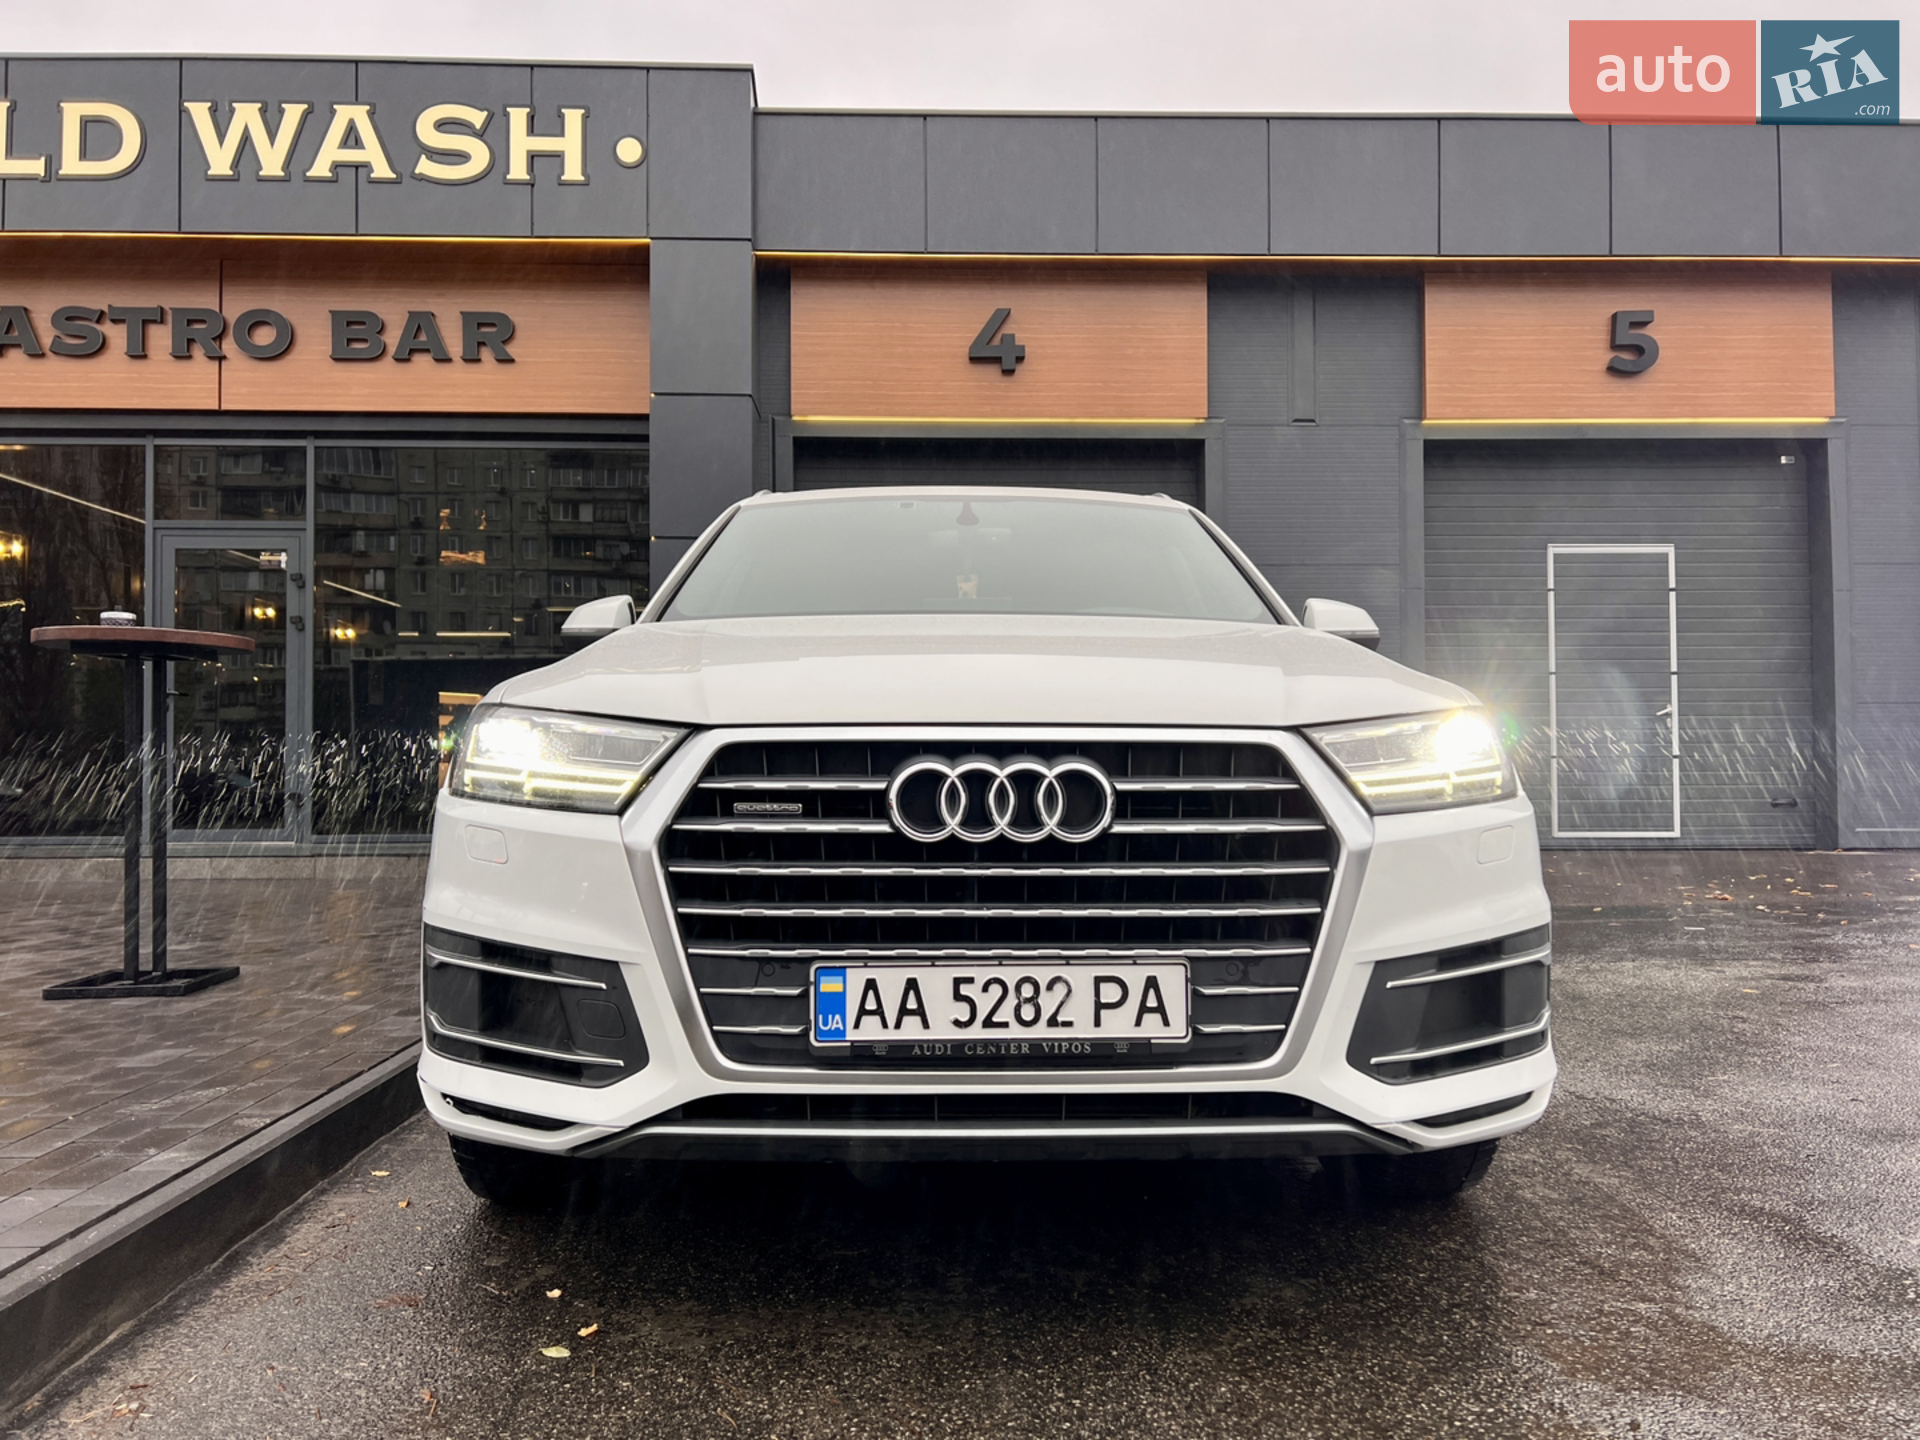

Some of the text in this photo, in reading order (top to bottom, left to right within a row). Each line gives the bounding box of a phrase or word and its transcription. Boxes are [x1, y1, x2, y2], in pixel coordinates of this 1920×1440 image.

[183, 101, 589, 183] WASH
[0, 305, 516, 362] ASTRO BAR
[968, 307, 1026, 374] 4
[1606, 309, 1660, 375] 5
[736, 803, 800, 813] quattro
[818, 1014, 844, 1031] UA
[853, 974, 1171, 1030] AA 5282 PA
[911, 1041, 1092, 1055] AUDI CENTER VIPOS
